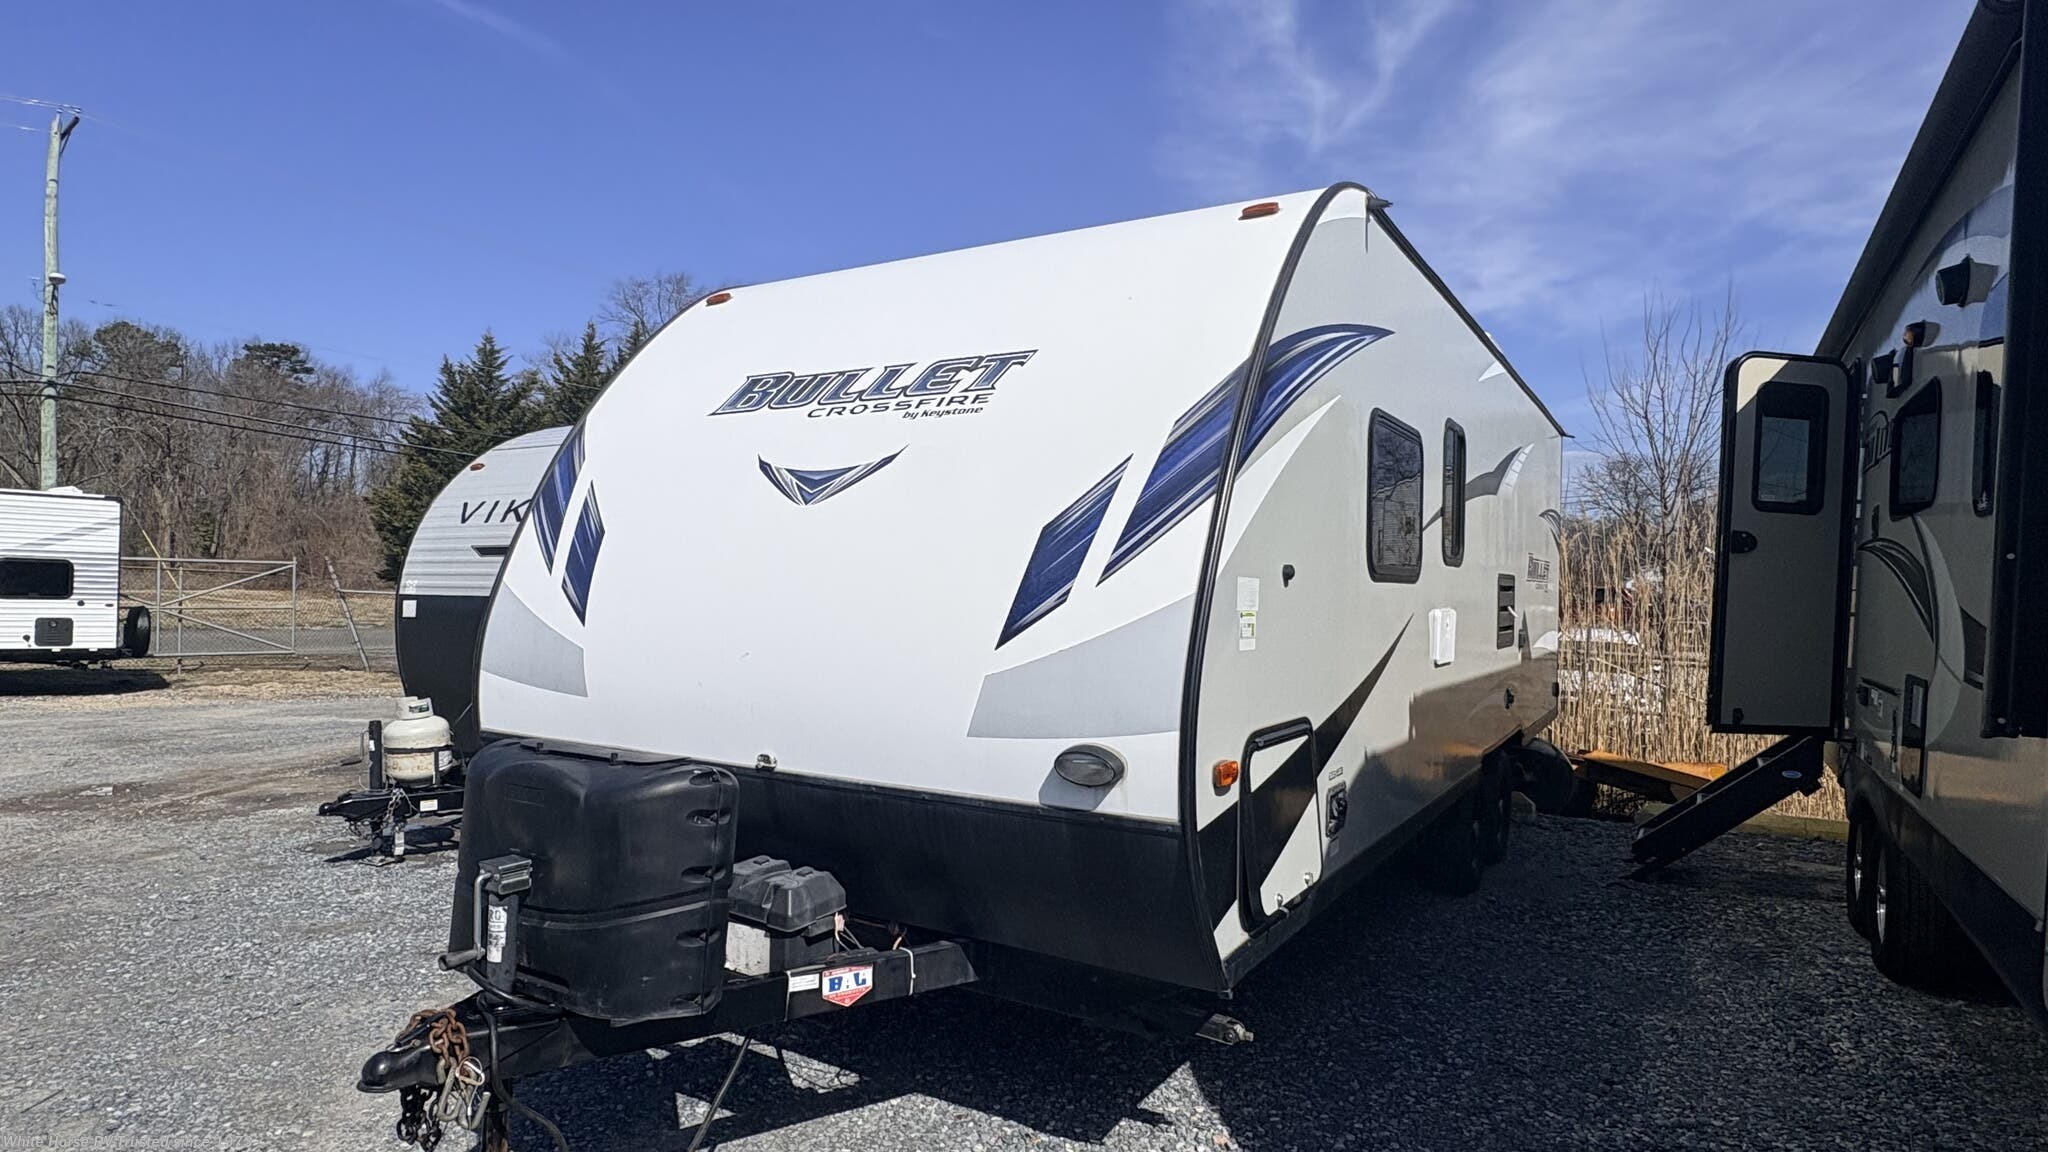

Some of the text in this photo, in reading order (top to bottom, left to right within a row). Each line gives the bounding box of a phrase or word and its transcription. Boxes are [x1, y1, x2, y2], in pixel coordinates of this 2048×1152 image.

[706, 349, 1039, 416] BULLET
[807, 392, 994, 418] CROSSFIRE
[902, 411, 919, 420] by
